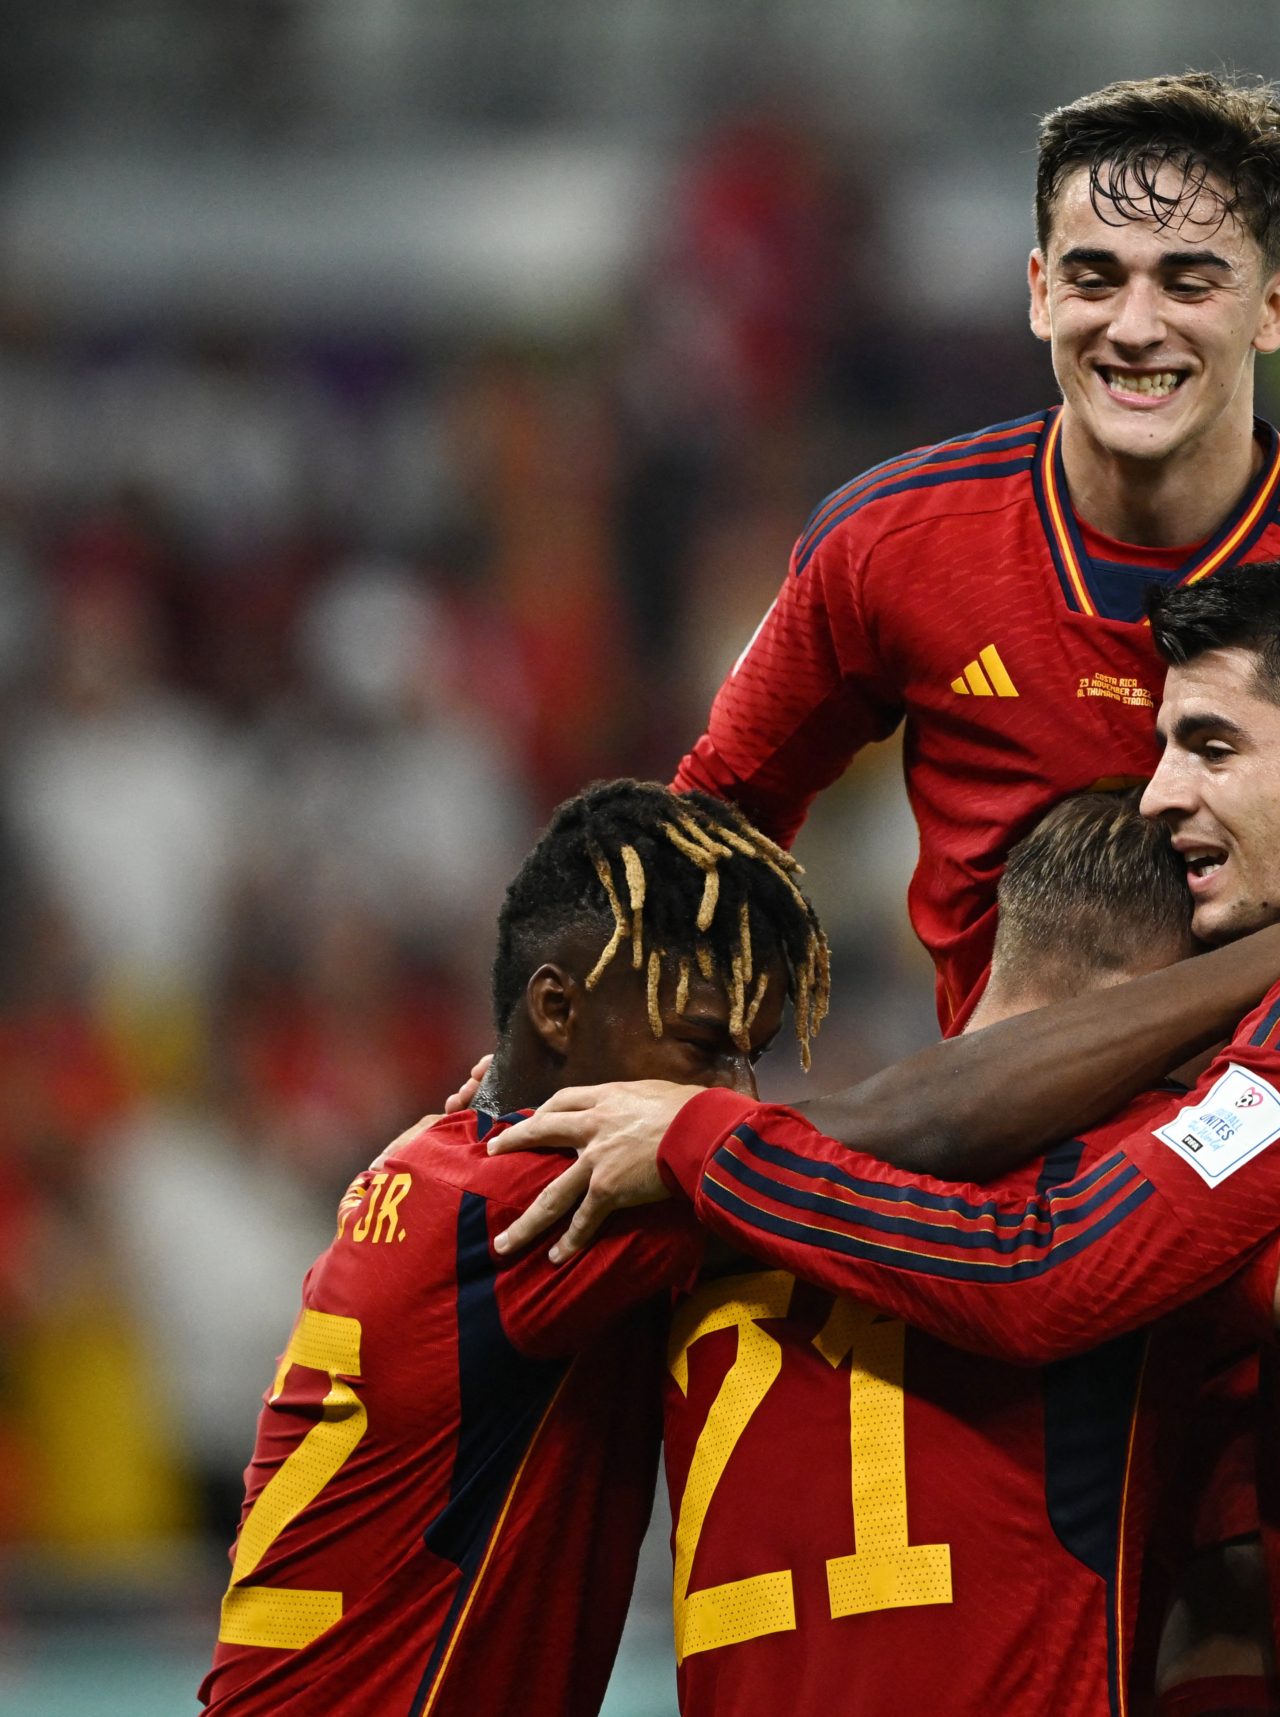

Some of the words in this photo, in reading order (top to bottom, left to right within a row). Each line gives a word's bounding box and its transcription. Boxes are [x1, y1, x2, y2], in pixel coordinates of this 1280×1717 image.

[1080, 678, 1089, 688] 23
[1095, 672, 1117, 686] COSTA
[1119, 678, 1138, 688] RICA
[1200, 1113, 1235, 1141] UNITES
[353, 1173, 412, 1243] JR.
[668, 1270, 953, 1667] 21
